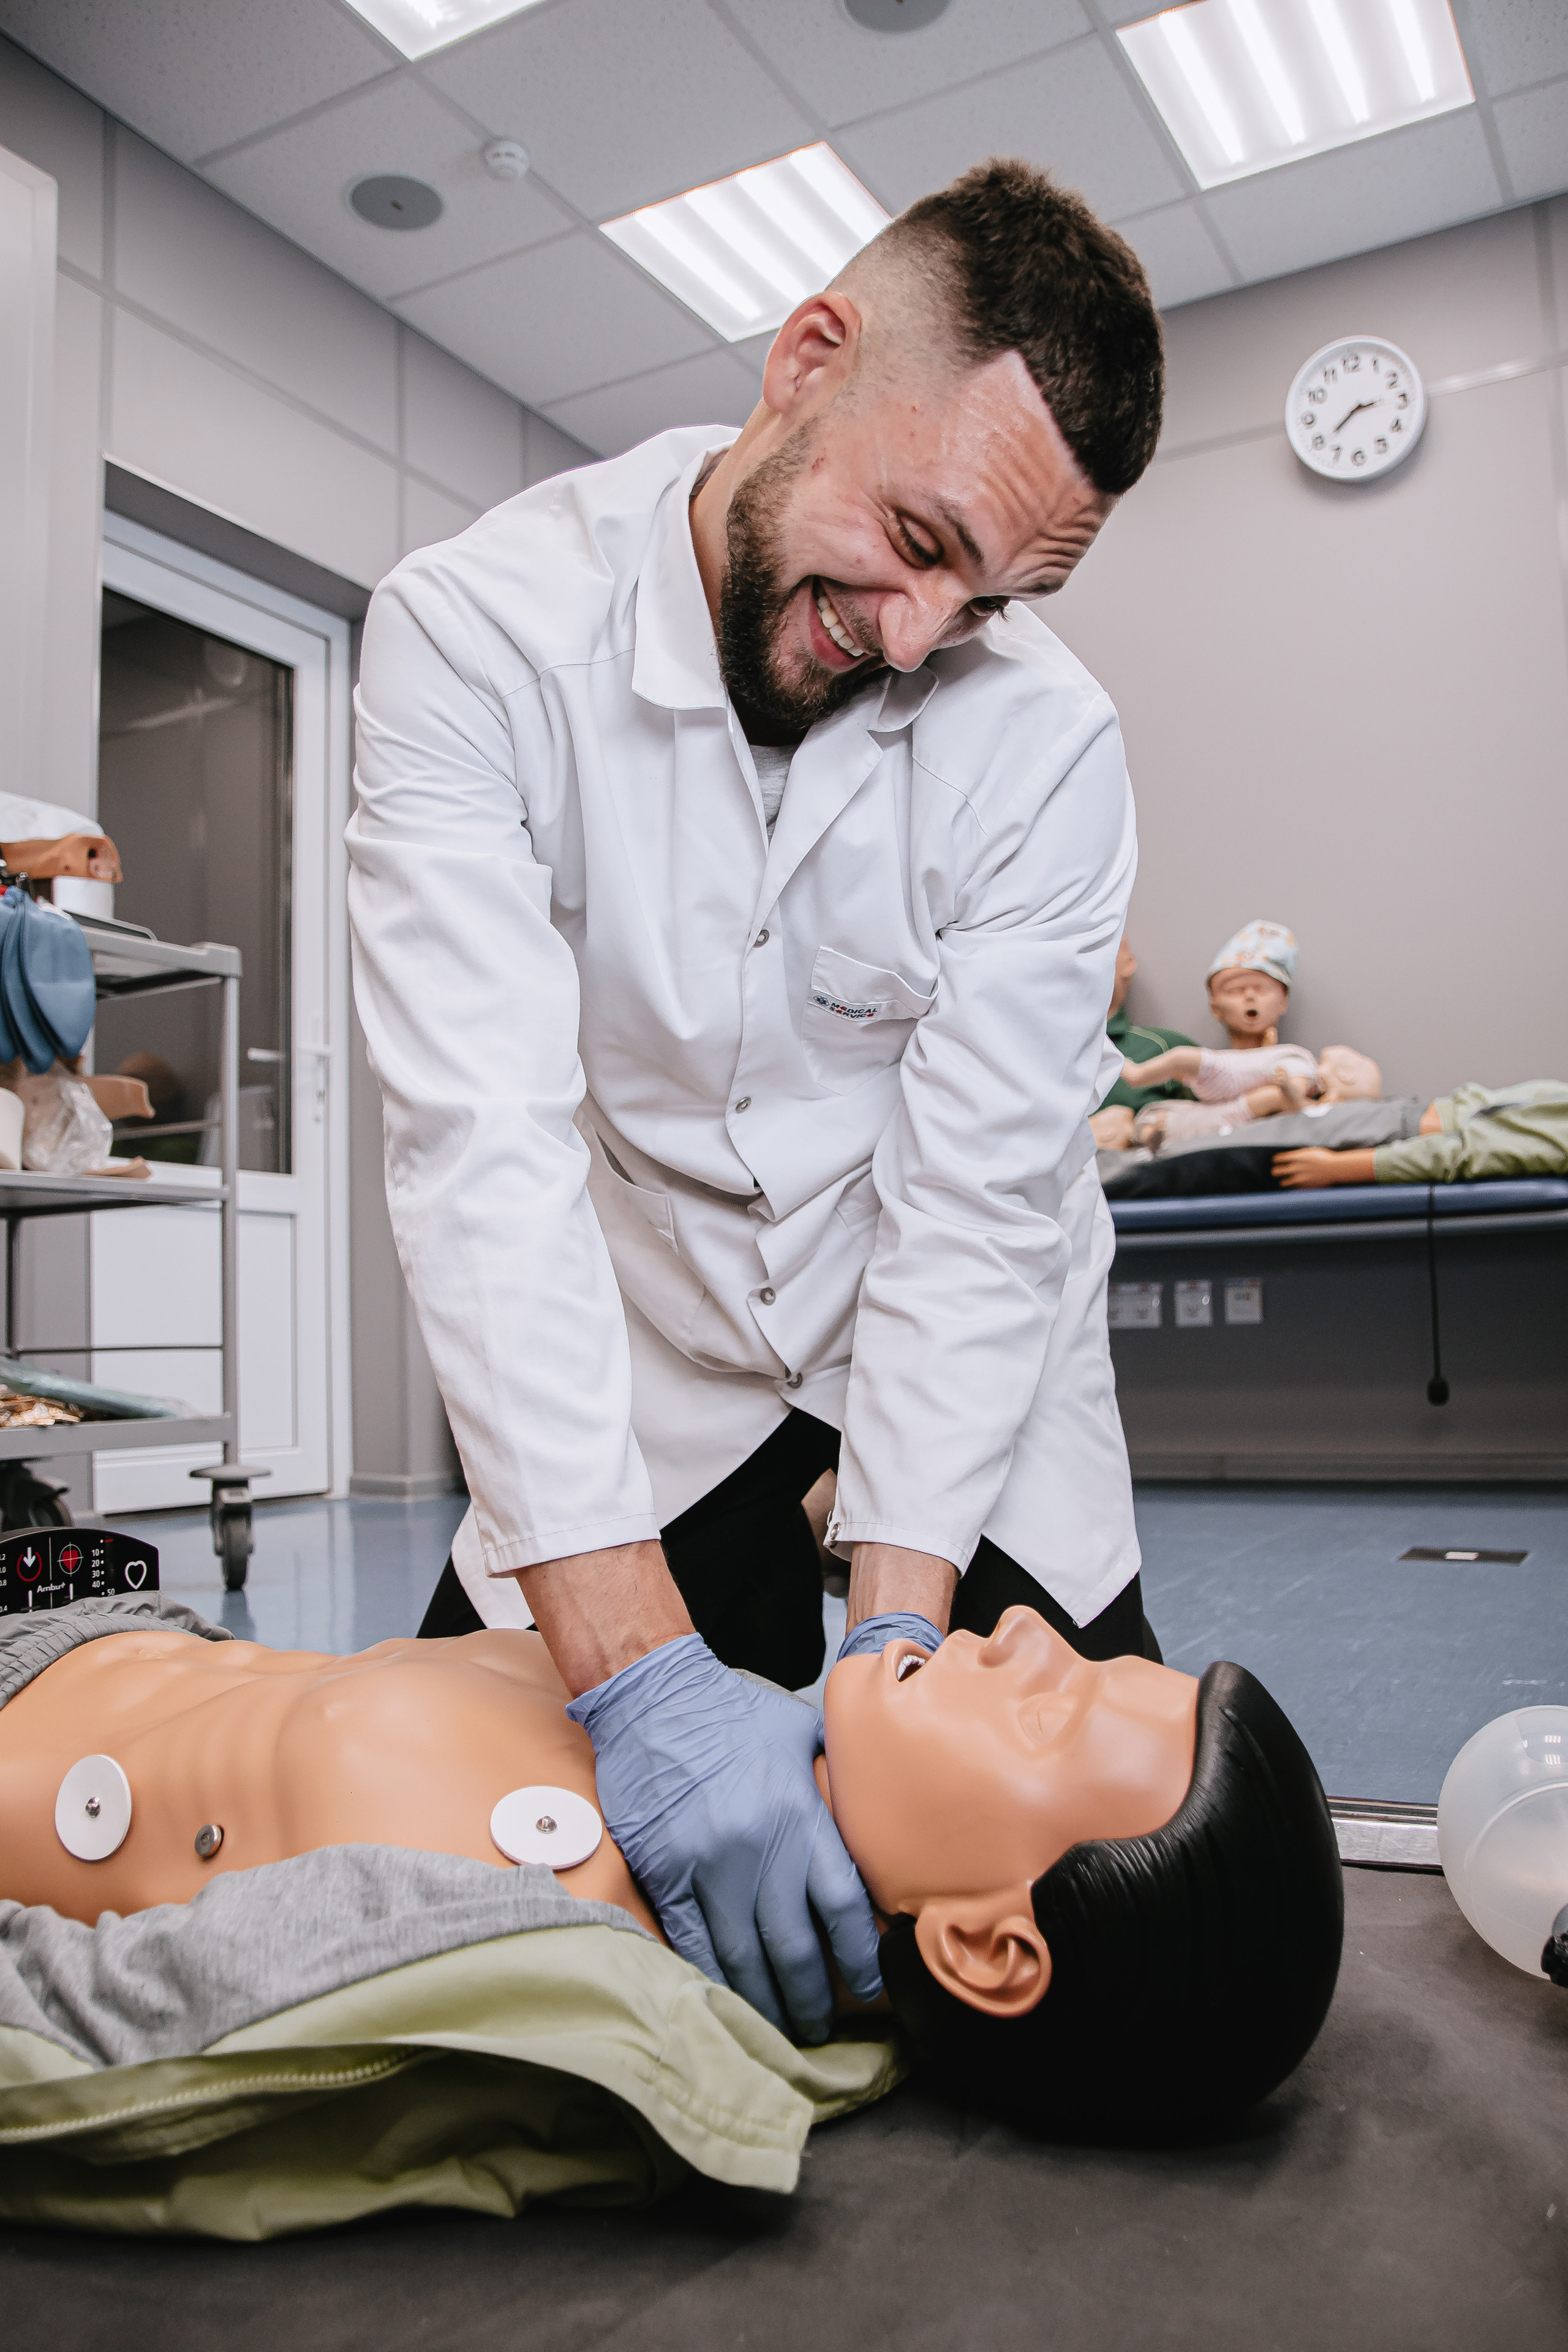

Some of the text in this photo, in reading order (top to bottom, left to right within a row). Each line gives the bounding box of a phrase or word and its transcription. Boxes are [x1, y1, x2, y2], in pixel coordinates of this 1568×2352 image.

[1342, 355, 1359, 371] 12
[1324, 368, 1338, 384] 11
[1386, 372, 1398, 389] 2
[1308, 388, 1327, 404] 10
[1396, 393, 1408, 409] 3
[1390, 419, 1402, 432] 4
[1375, 438, 1387, 453] 5
[1332, 446, 1341, 462] 7
[1351, 450, 1366, 465] 6
[829, 1006, 875, 1018] SERVICE
[831, 1002, 878, 1014] MEDICAL
[91, 1559, 100, 1567] 20
[91, 1569, 100, 1578] 30
[37, 1583, 61, 1593] Ambu
[91, 1580, 100, 1588] 40
[107, 1588, 115, 1596] 50
